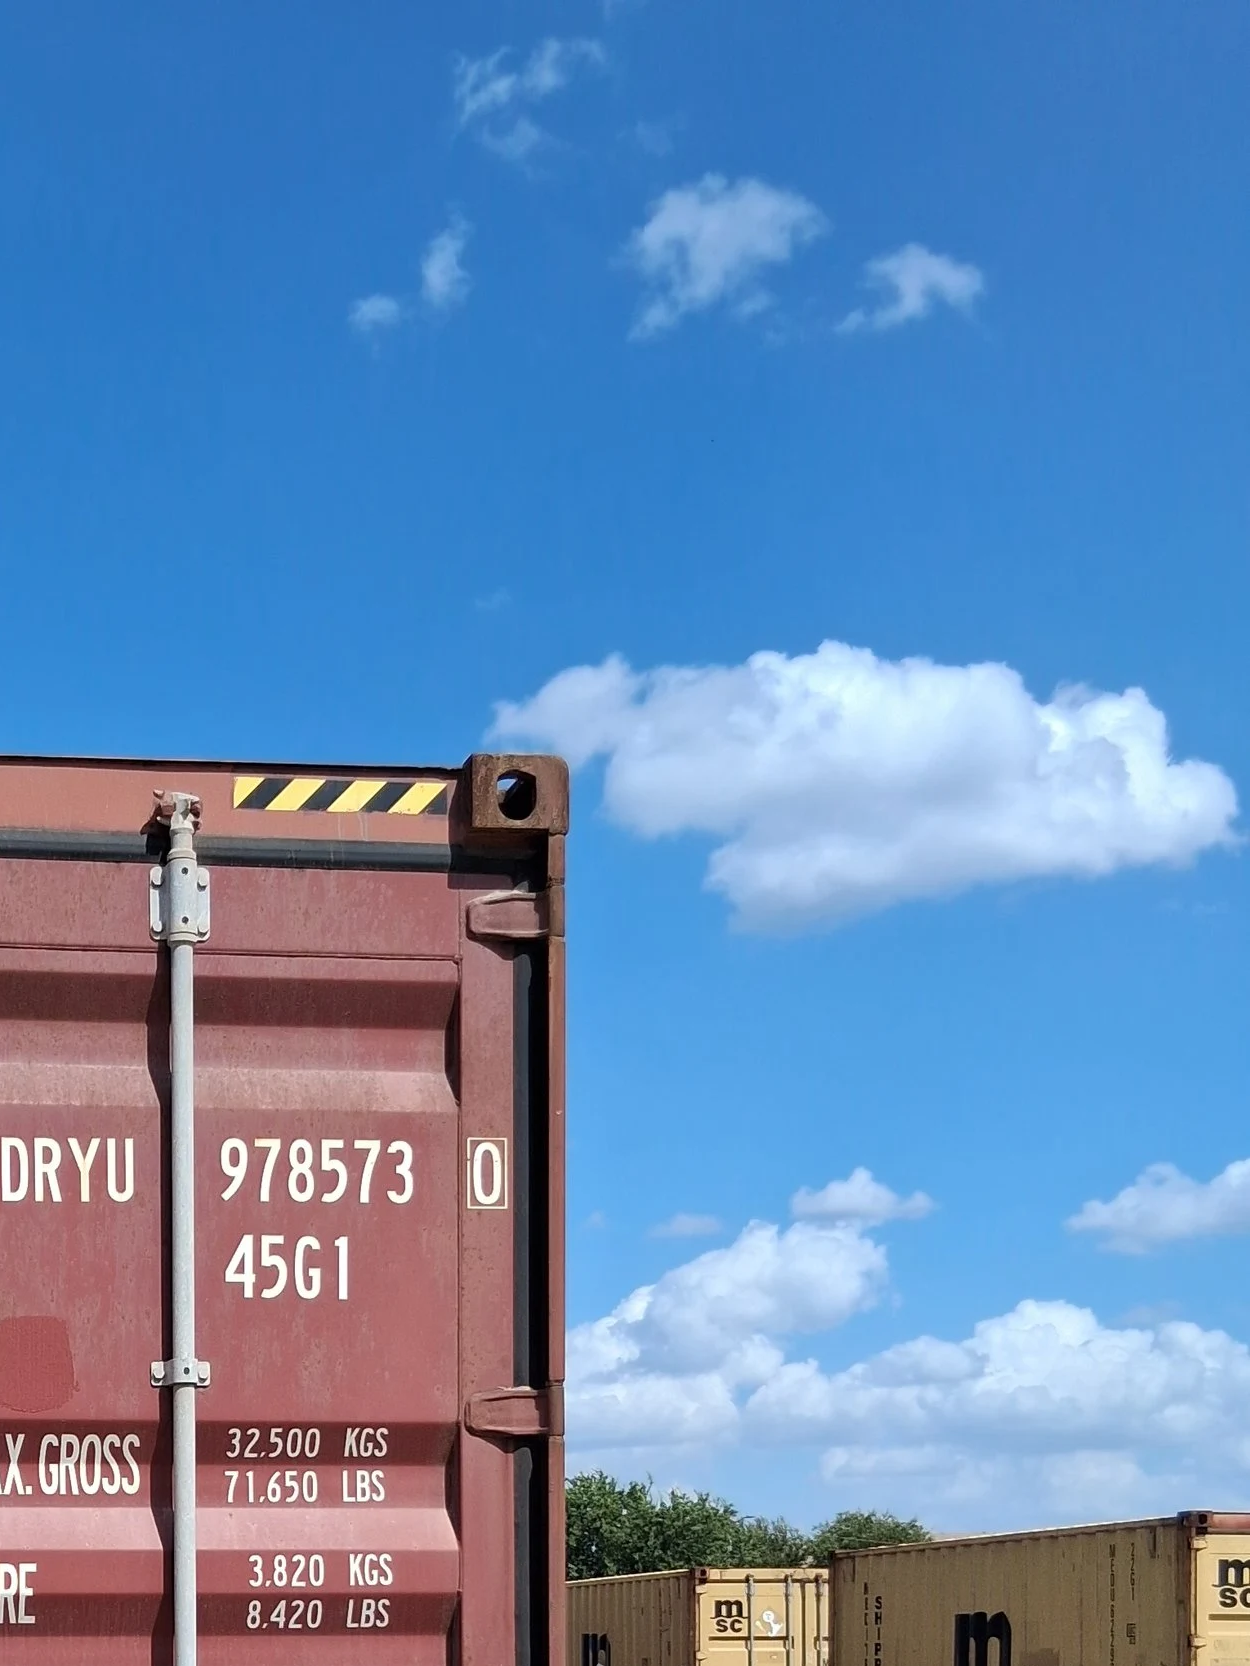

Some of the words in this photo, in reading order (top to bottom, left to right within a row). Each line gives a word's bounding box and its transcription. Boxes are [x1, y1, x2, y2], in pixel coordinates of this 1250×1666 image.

[0, 1136, 135, 1203] DRYU
[219, 1137, 415, 1204] 978573
[471, 1140, 503, 1206] 0
[224, 1234, 350, 1300] 45G1
[225, 1427, 321, 1459] 32,500
[343, 1427, 390, 1458] KGS
[38, 1432, 141, 1496] GROSS
[223, 1469, 319, 1504] 71,650
[341, 1469, 386, 1503] LBS
[248, 1553, 325, 1588] 3,820
[349, 1552, 394, 1587] KGS
[245, 1598, 324, 1631] 8,420
[345, 1597, 391, 1629] LBS
